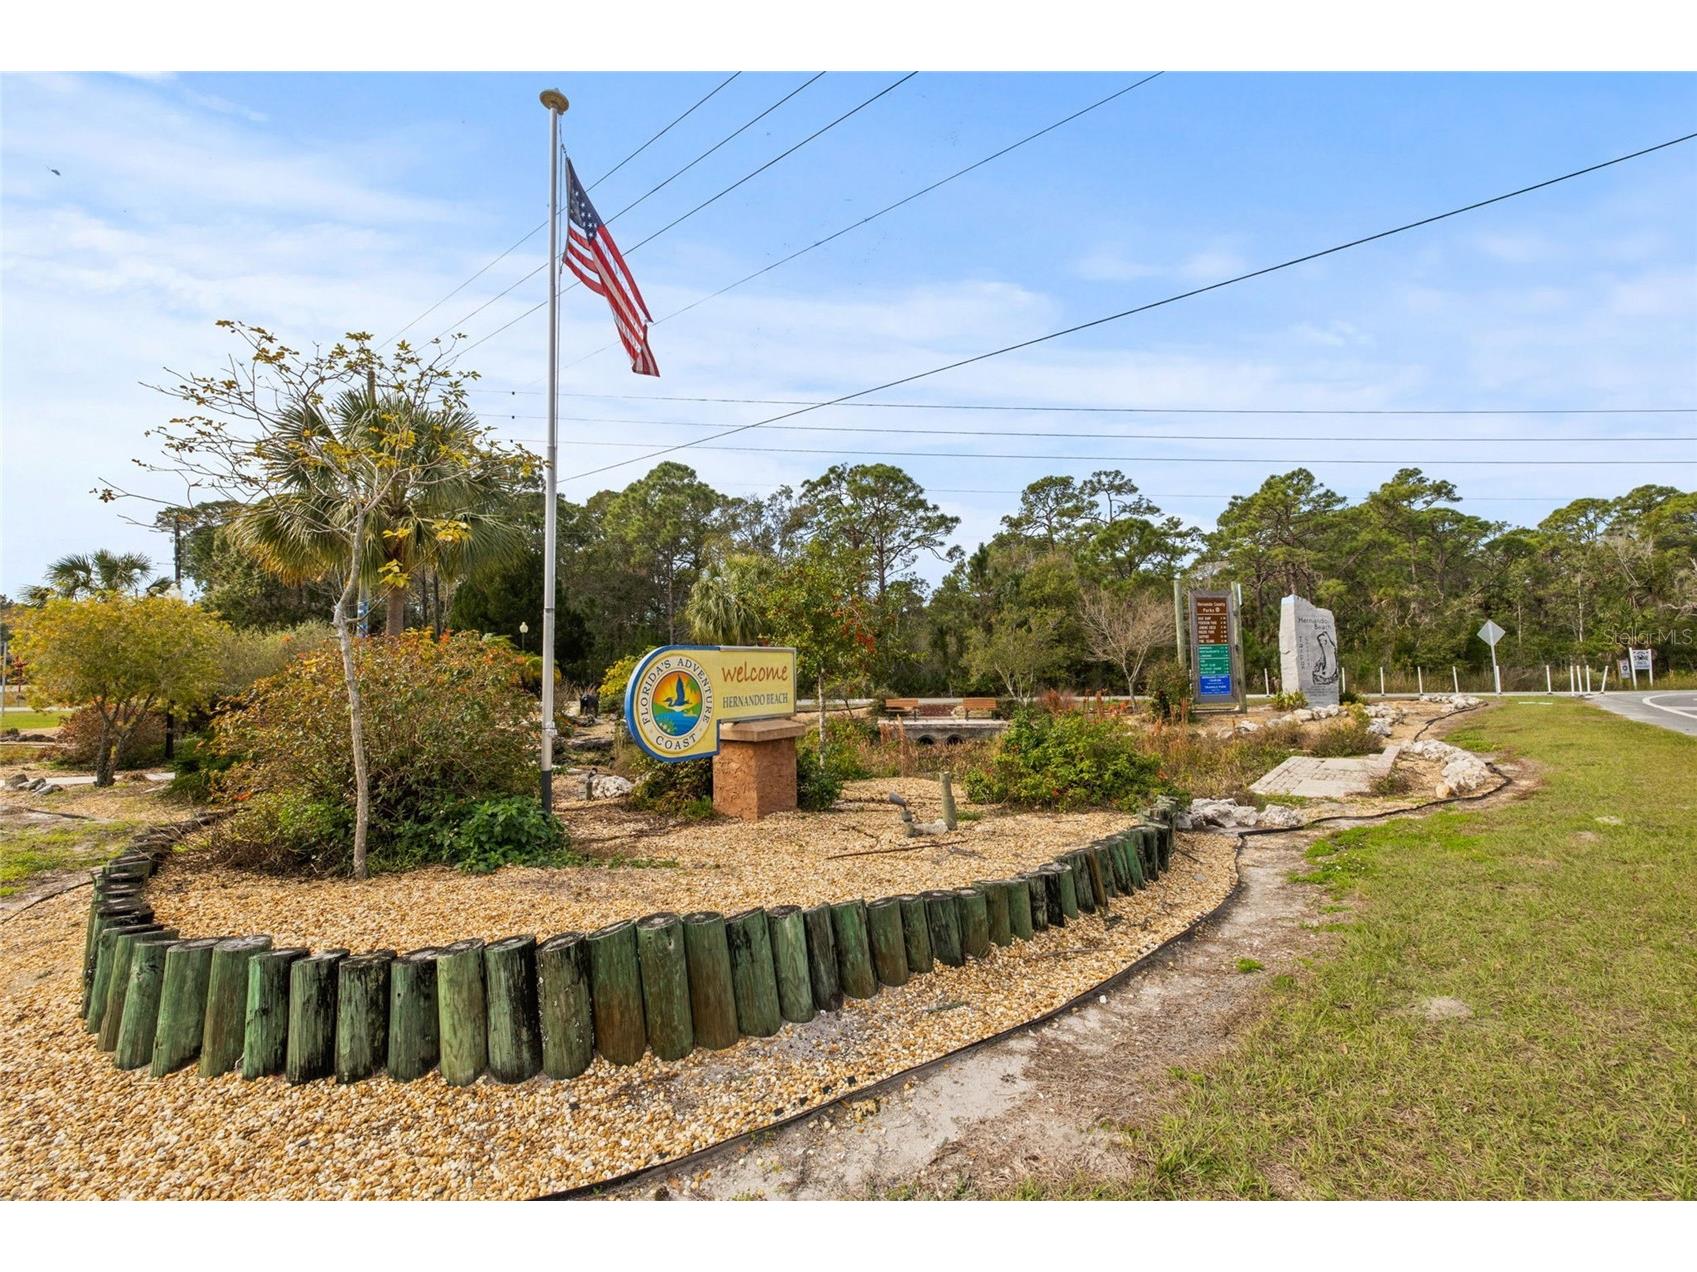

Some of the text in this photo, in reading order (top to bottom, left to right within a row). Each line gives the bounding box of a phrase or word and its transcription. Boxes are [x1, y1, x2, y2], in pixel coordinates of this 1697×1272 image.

[639, 657, 713, 726] FLORIDA'S ADVENTURE
[722, 692, 789, 709] HERNANDO BEACH
[655, 733, 697, 751] COAST
